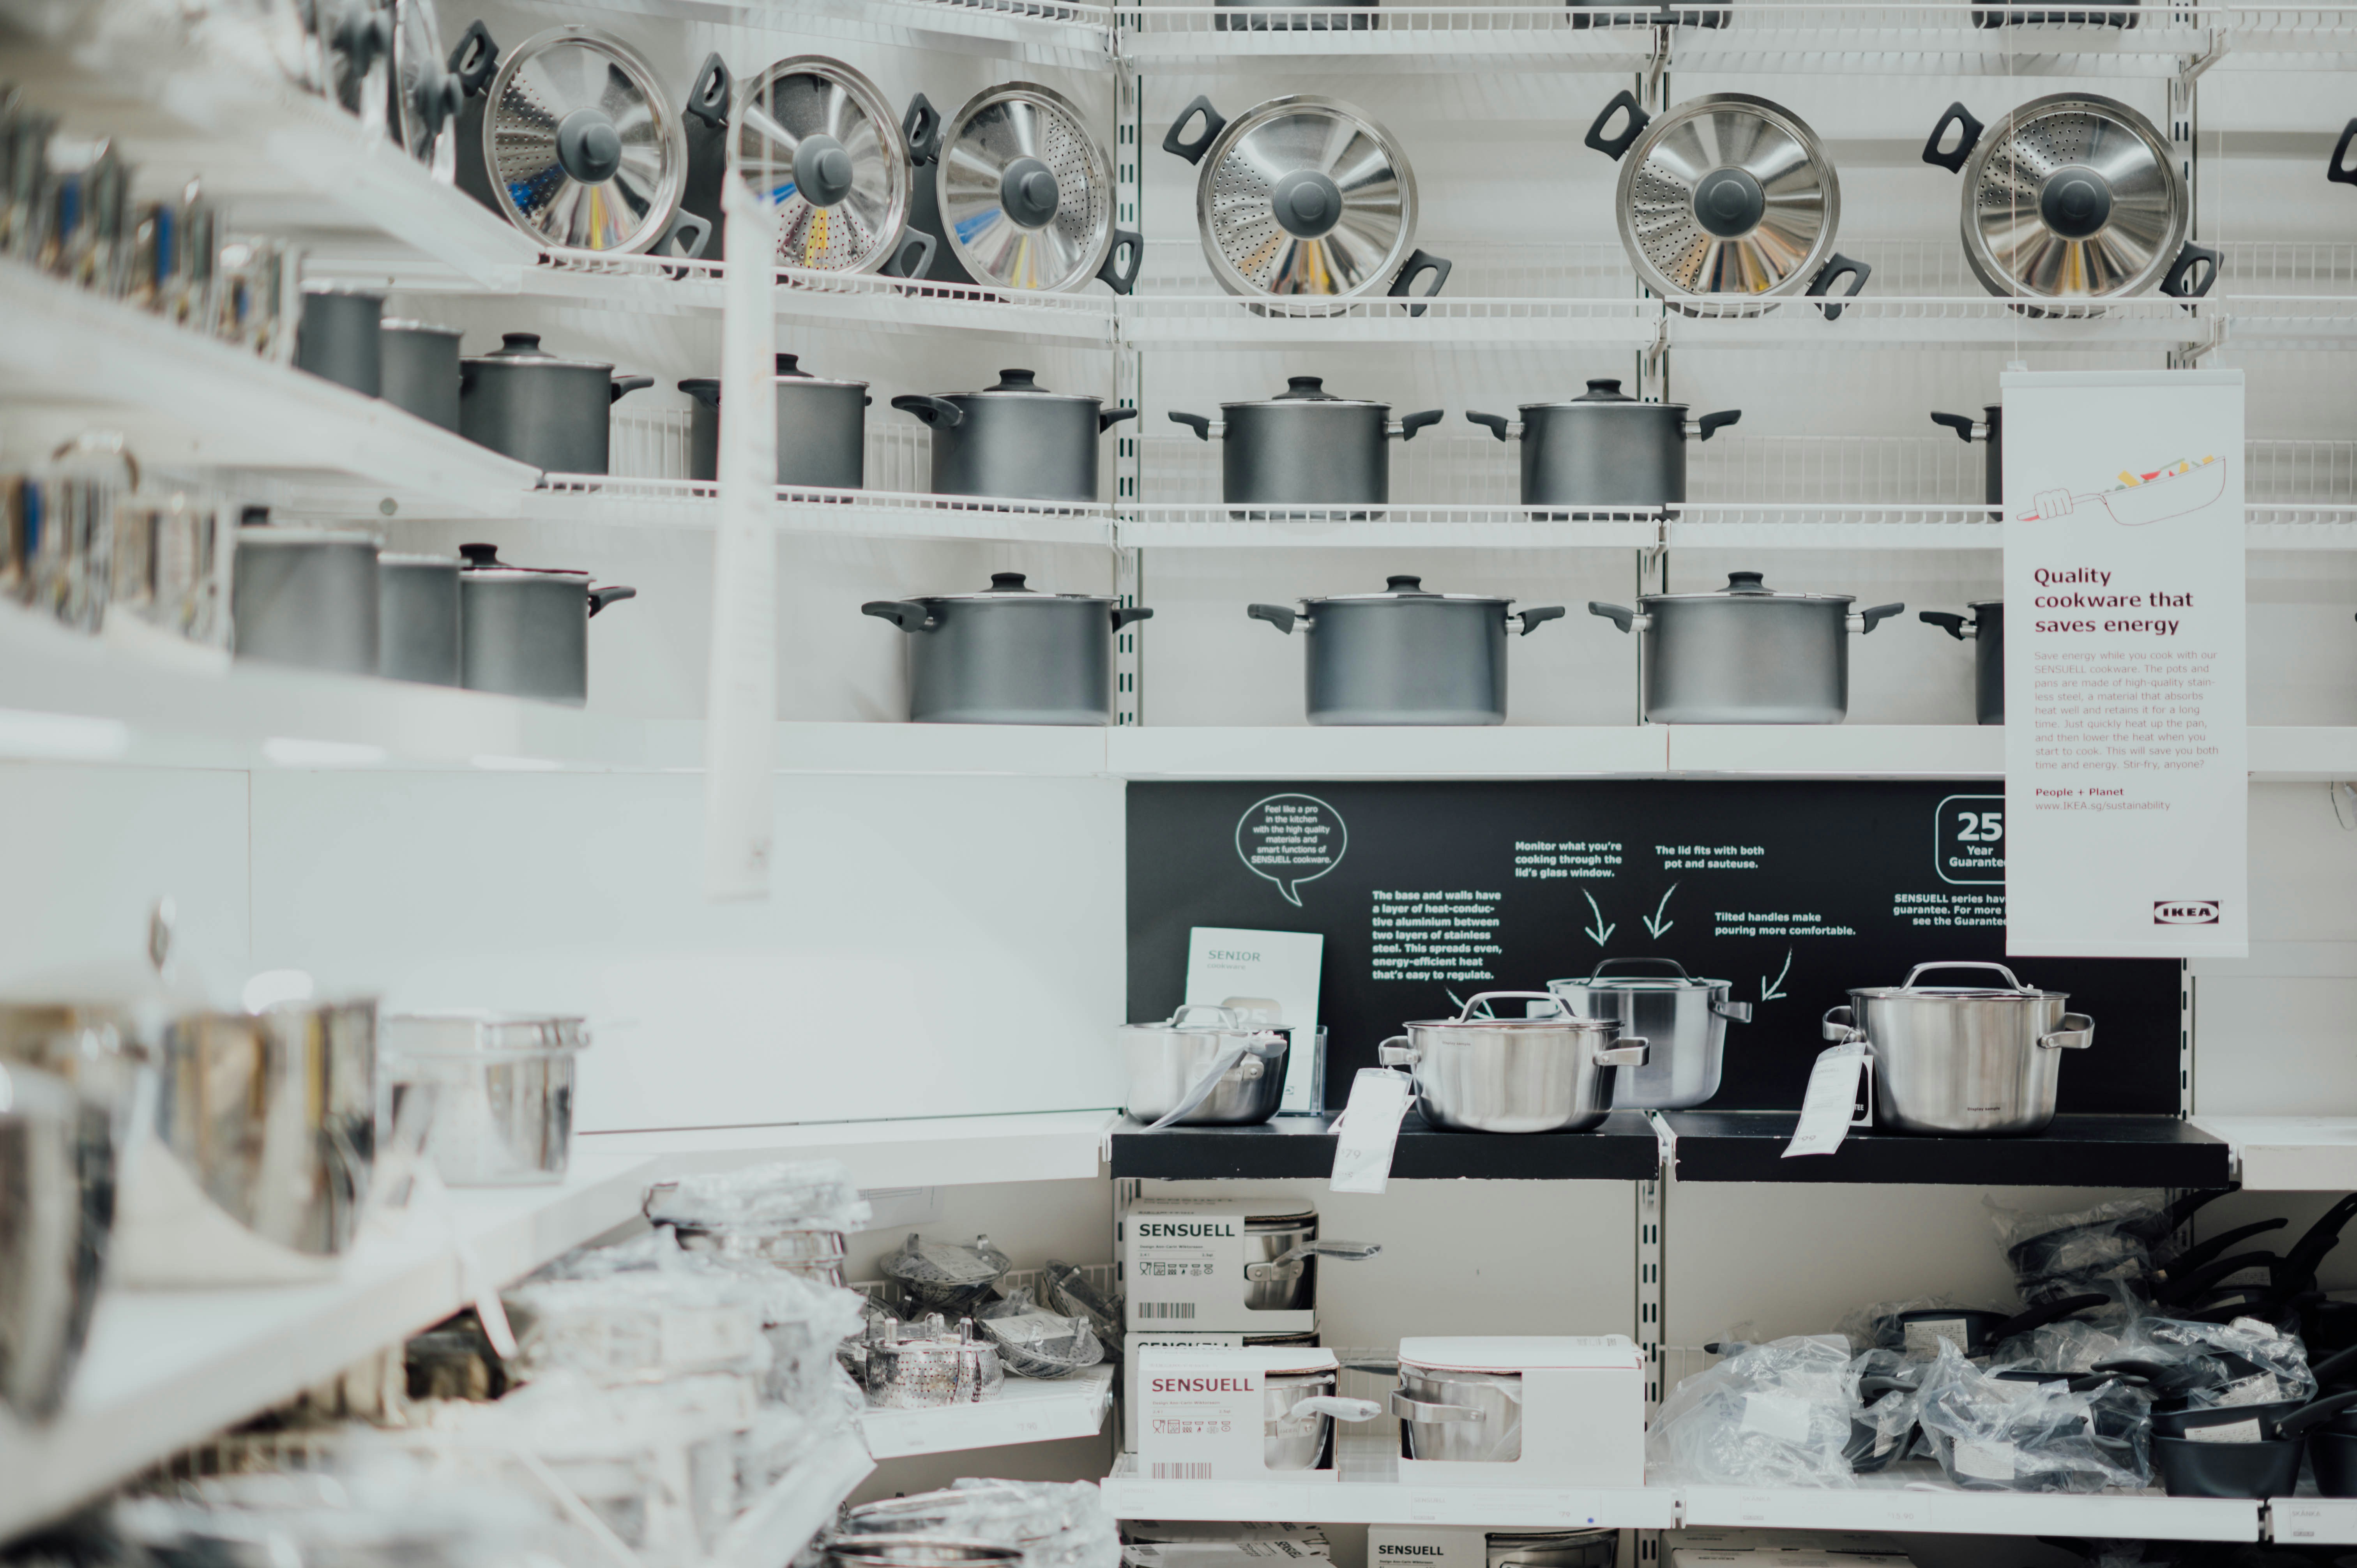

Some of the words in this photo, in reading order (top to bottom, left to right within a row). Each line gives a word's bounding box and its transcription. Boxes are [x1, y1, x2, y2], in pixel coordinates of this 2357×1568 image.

[2034, 567, 2111, 587] Quality
[2035, 592, 2141, 607] cookware
[2149, 592, 2193, 607] that
[2035, 621, 2096, 632] saves
[2104, 620, 2179, 636] energy
[2062, 653, 2096, 662] energy
[2100, 651, 2125, 660] while
[2129, 653, 2147, 661] you
[2150, 651, 2173, 660] cook
[2177, 650, 2197, 659] with
[2035, 665, 2086, 674] SENSUELL
[2090, 665, 2140, 673] cookware.
[2145, 664, 2163, 673] The
[2166, 665, 2187, 675] pots
[2191, 664, 2209, 673] and
[2035, 681, 2058, 689] pans
[2081, 679, 2109, 687] made
[2112, 678, 2122, 687] of
[2126, 678, 2184, 689] high-quality
[2035, 720, 2060, 728] time.
[2065, 720, 2083, 728] Just
[2087, 720, 2122, 730] quickly
[2126, 719, 2147, 727] heat
[2151, 721, 2163, 729] up
[2166, 719, 2182, 727] the
[2186, 720, 2207, 730] pan,
[2035, 733, 2053, 742] and
[2083, 733, 2109, 742] lower
[2113, 733, 2129, 742] the
[2133, 733, 2154, 742] heat
[2158, 732, 2184, 741] when
[2188, 734, 2206, 743] you
[2061, 760, 2079, 769] and
[2083, 762, 2119, 770] energy.
[2124, 760, 2159, 770] Stir-fry,
[2164, 759, 2204, 770] anyone?
[2036, 788, 2073, 798] People
[1265, 805, 1281, 813] Feel
[1283, 805, 1296, 813] like
[2035, 801, 2170, 812] www.IKEA.sg/sustainability
[1286, 825, 1303, 835] high
[1304, 825, 1330, 834] quality
[1957, 812, 2003, 842] 25
[1266, 835, 1301, 843] materials
[1281, 845, 1316, 853] functions
[1318, 845, 1327, 853] of
[1515, 841, 1557, 851] Monitor
[1558, 841, 1586, 851] what
[1588, 841, 1622, 853] you're
[1655, 845, 1675, 855] The
[1678, 845, 1691, 855] lid
[1693, 845, 1711, 855] fits
[1714, 846, 1737, 855] with
[1740, 846, 1765, 855] both
[1967, 845, 1993, 856] Year
[1251, 855, 1291, 863] SENSUELL
[1514, 854, 1557, 866] cooking
[1559, 854, 1602, 866] through
[1604, 855, 1622, 864] the
[1664, 859, 1682, 870] pot
[1684, 859, 1705, 869] and
[1707, 859, 1758, 869] sauteuse.
[1949, 857, 2005, 867] Guarante
[1515, 867, 1538, 878] lid's
[1539, 867, 1568, 879] glass
[1570, 867, 1615, 878] window.
[1372, 890, 1393, 901] The
[1394, 890, 1421, 901] base
[1422, 890, 1443, 901] and
[1444, 890, 1474, 900] walls
[1475, 890, 1502, 900] have
[1894, 893, 1949, 903] SENSUELL
[1951, 894, 1983, 903] series
[1986, 894, 2005, 903] hav
[1372, 905, 1380, 914] a
[1381, 903, 1410, 915] layer
[1410, 903, 1423, 914] of
[1424, 904, 1495, 914] heat-conduc-
[1893, 905, 1951, 916] guarantee.
[1954, 905, 1972, 915] For
[2163, 908, 2212, 917] IKEA
[1372, 917, 1394, 927] tive
[1395, 917, 1452, 927] aluminium
[1453, 917, 1500, 927] between
[1715, 912, 1745, 922] Tilted
[1748, 912, 1790, 922] handles
[1792, 912, 1821, 922] make
[1933, 916, 1951, 925] the
[1372, 931, 1394, 940] two
[1395, 930, 1428, 941] layers
[1430, 930, 1442, 940] of
[1444, 930, 1491, 940] stainless
[1715, 925, 1756, 937] pouring
[1758, 927, 1786, 935] more
[1789, 925, 1856, 936] comfortable.
[1372, 943, 1402, 953] steel.
[1404, 943, 1427, 953] This
[1429, 943, 1472, 955] spreads
[1473, 945, 1502, 954] even,
[1209, 950, 1260, 962] SENIOR
[1372, 956, 1457, 968] energy-efficient
[1458, 957, 1483, 966] heat
[1372, 970, 1404, 980] that's
[1405, 971, 1431, 981] easy
[1432, 970, 1445, 980] to
[1446, 970, 1494, 982] regulate.
[1140, 1224, 1235, 1237] SENSUELL
[1152, 1378, 1254, 1392] SENSUELL
[2292, 1508, 2321, 1517] SKÄNKA
[1378, 1545, 1444, 1556] SENSUELL
